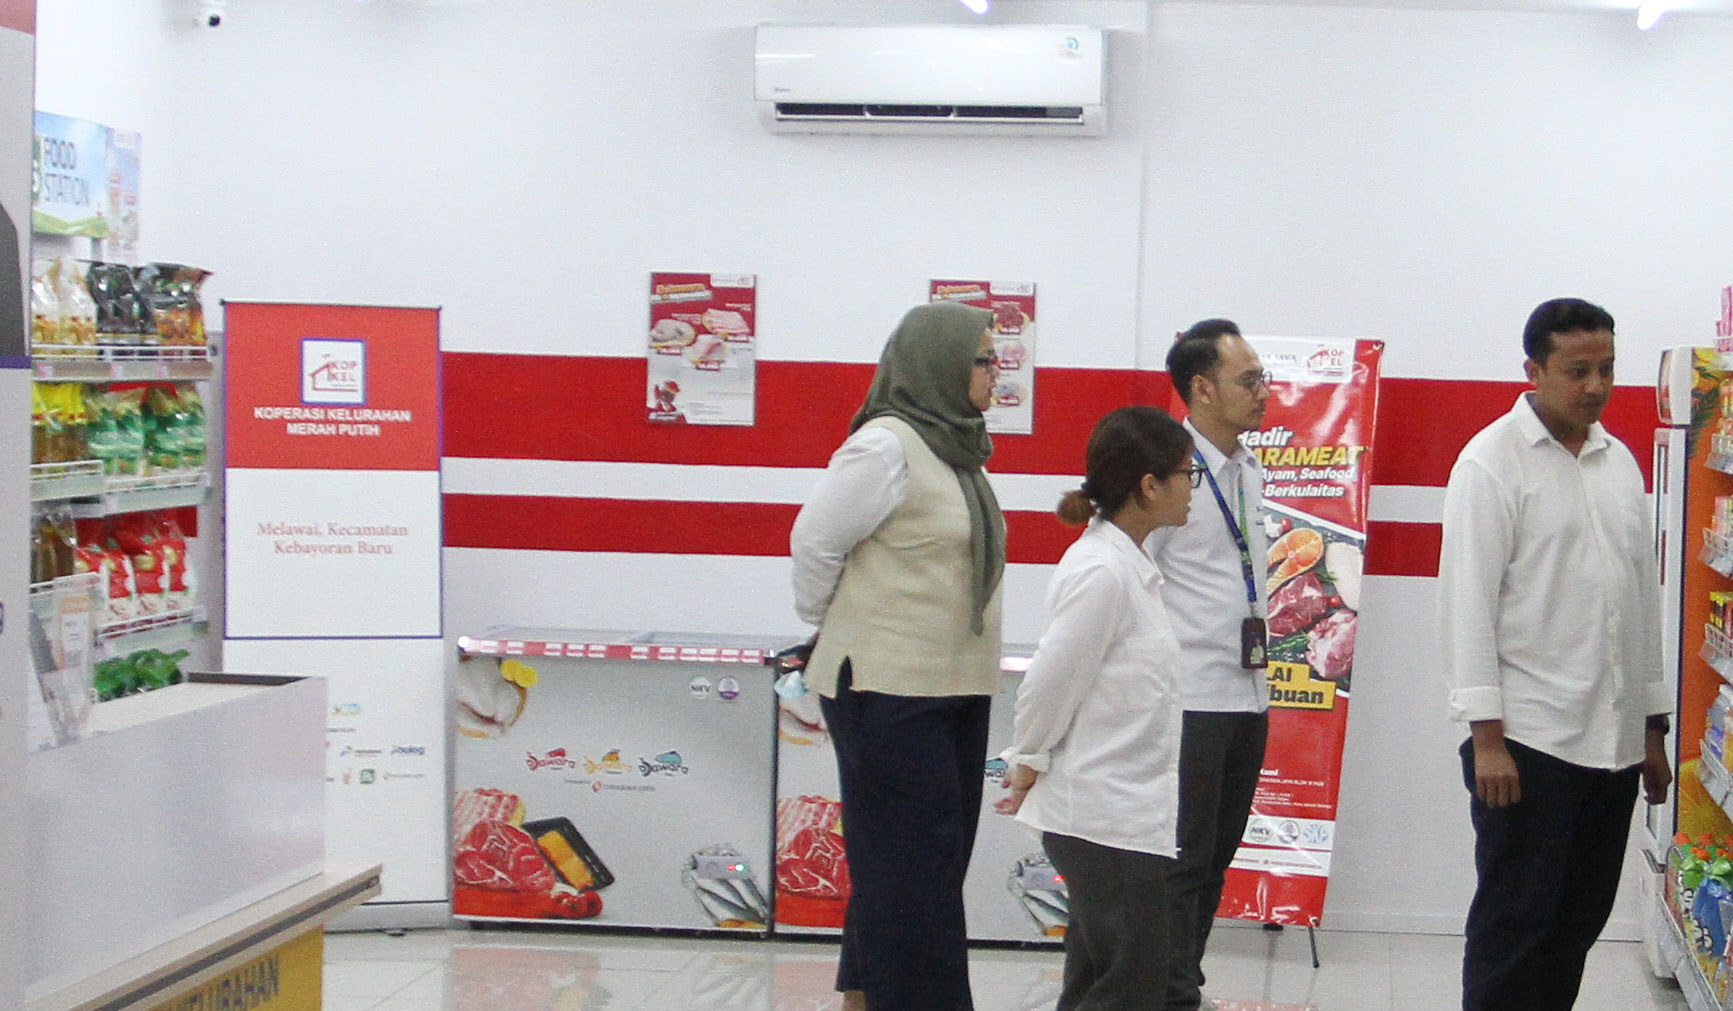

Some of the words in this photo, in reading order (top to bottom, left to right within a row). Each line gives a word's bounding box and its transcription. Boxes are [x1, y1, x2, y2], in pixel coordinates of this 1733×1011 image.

[44, 136, 77, 170] FOOD
[44, 172, 91, 206] STATION
[253, 406, 326, 421] KOPERASI
[327, 407, 412, 422] KELURAHAN
[286, 422, 337, 436] MERAH
[338, 423, 381, 437] PUTIH
[1262, 468, 1299, 483] Ayam,
[1300, 467, 1356, 481] Seafood
[256, 521, 322, 537] Melawai,
[327, 522, 410, 537] Kecamatan
[273, 540, 354, 557] Kebayoran
[357, 541, 394, 555] Baru
[1267, 684, 1324, 704] buan
